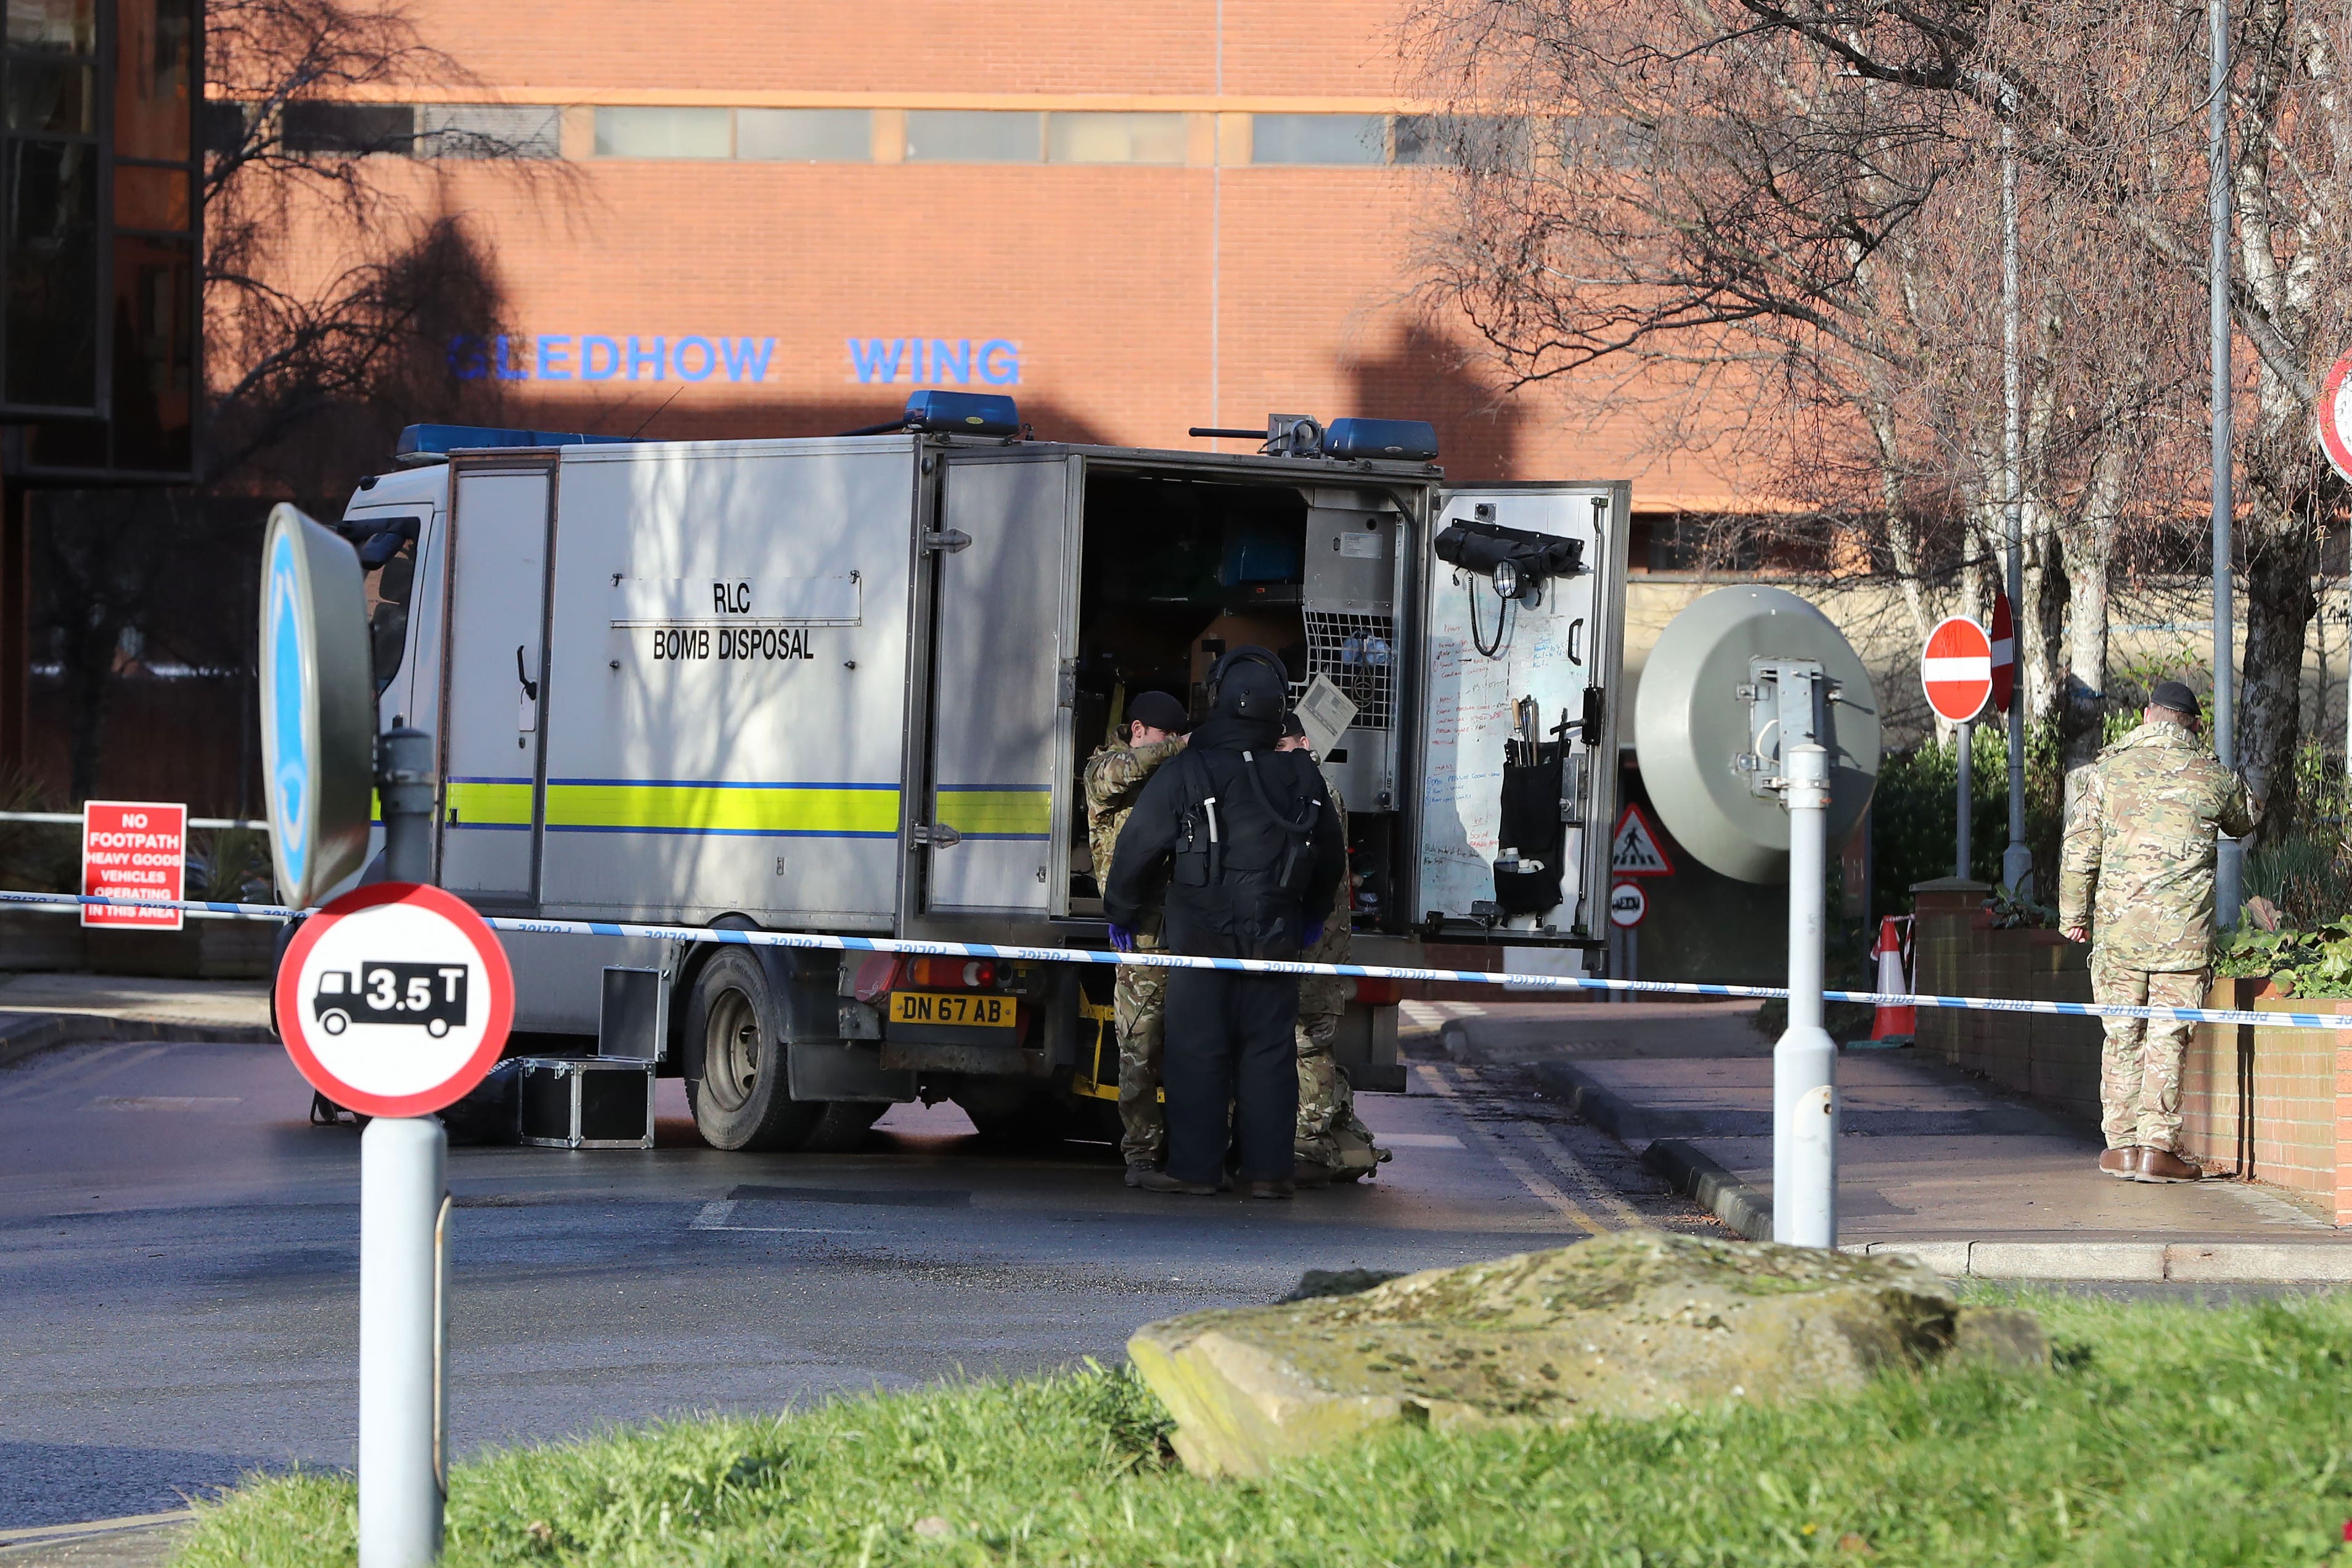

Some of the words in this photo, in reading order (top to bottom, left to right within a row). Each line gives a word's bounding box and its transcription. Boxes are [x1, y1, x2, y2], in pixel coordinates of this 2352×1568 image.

[447, 333, 776, 383] GLEDHOW
[849, 338, 1020, 385] WING
[713, 582, 751, 614] RLC
[653, 629, 709, 661] BOMB
[718, 629, 814, 661] DISPOSAL
[121, 813, 148, 829] NO
[89, 832, 179, 849] FOOTPATH
[86, 851, 129, 865] HEAVY
[132, 854, 181, 867] GOODS
[100, 870, 166, 884] VEHICLES
[94, 886, 172, 900] OPERATING
[88, 905, 103, 917] IN
[106, 905, 136, 918] THIS
[138, 907, 176, 919] AREA
[1745, 986, 1789, 997] OLICE
[903, 995, 933, 1021] DN
[937, 997, 968, 1021] 67
[974, 998, 1001, 1023] AB
